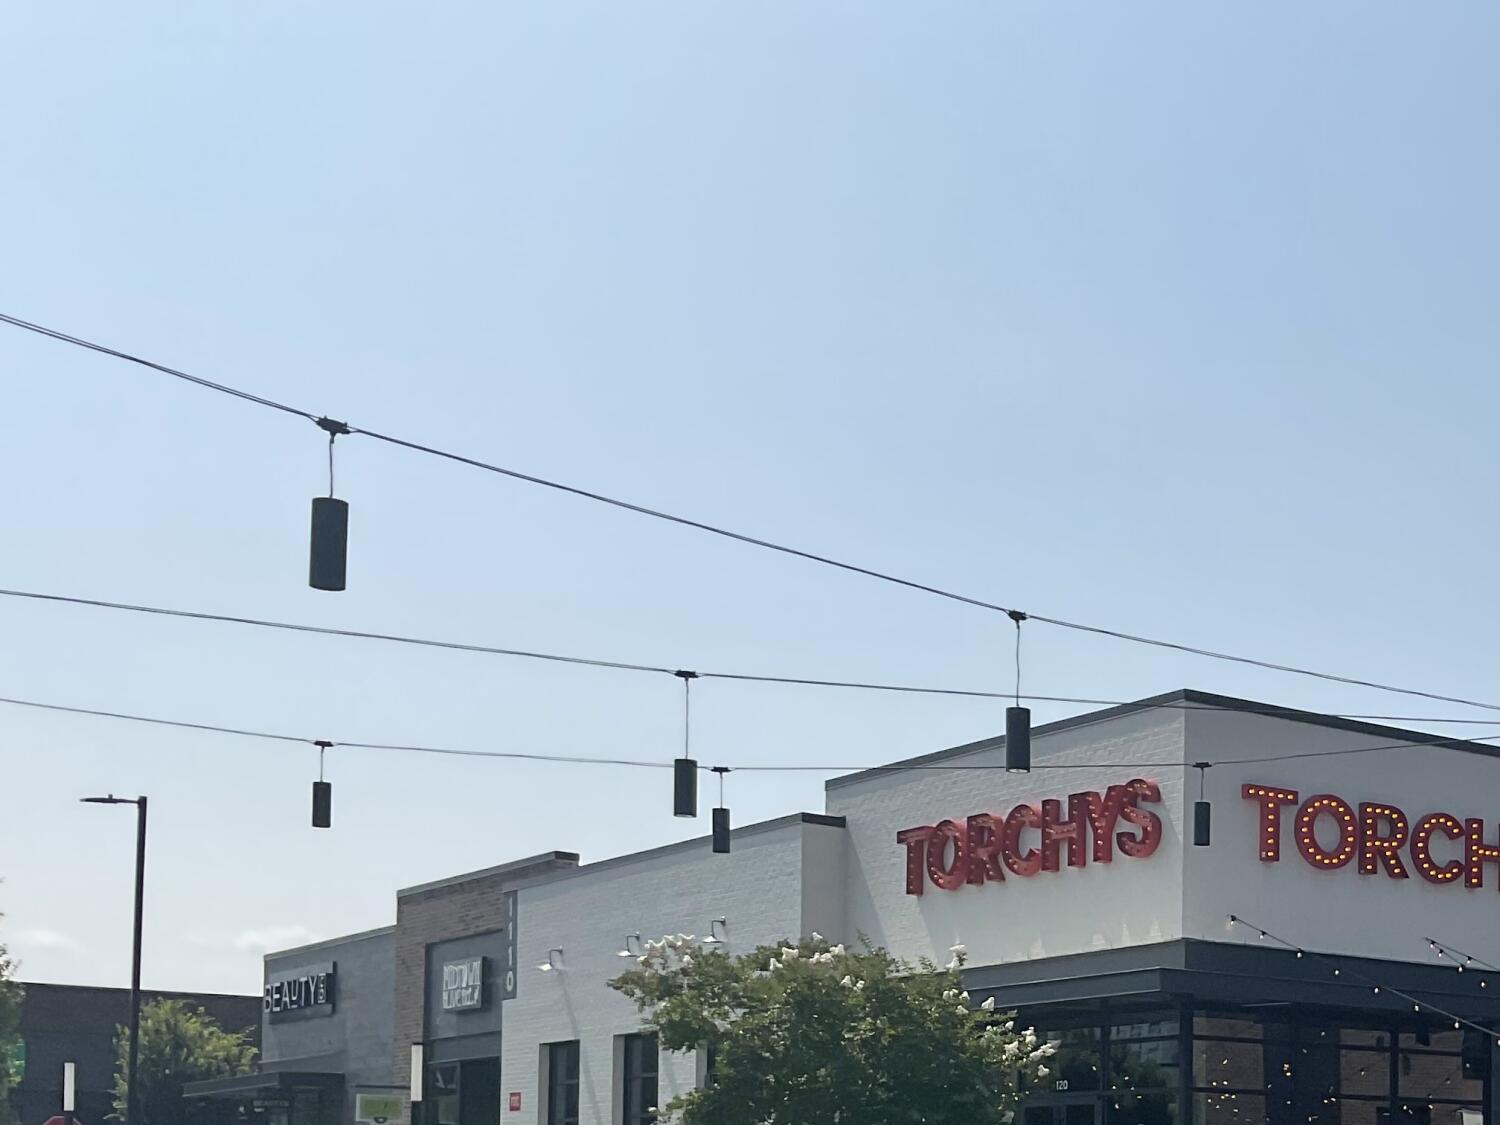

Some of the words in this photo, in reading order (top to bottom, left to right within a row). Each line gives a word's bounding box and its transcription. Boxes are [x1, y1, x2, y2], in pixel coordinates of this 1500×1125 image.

[897, 779, 1162, 896] TORCHYS
[264, 975, 318, 1013] BEAUTY
[1056, 1080, 1068, 1091] 120
